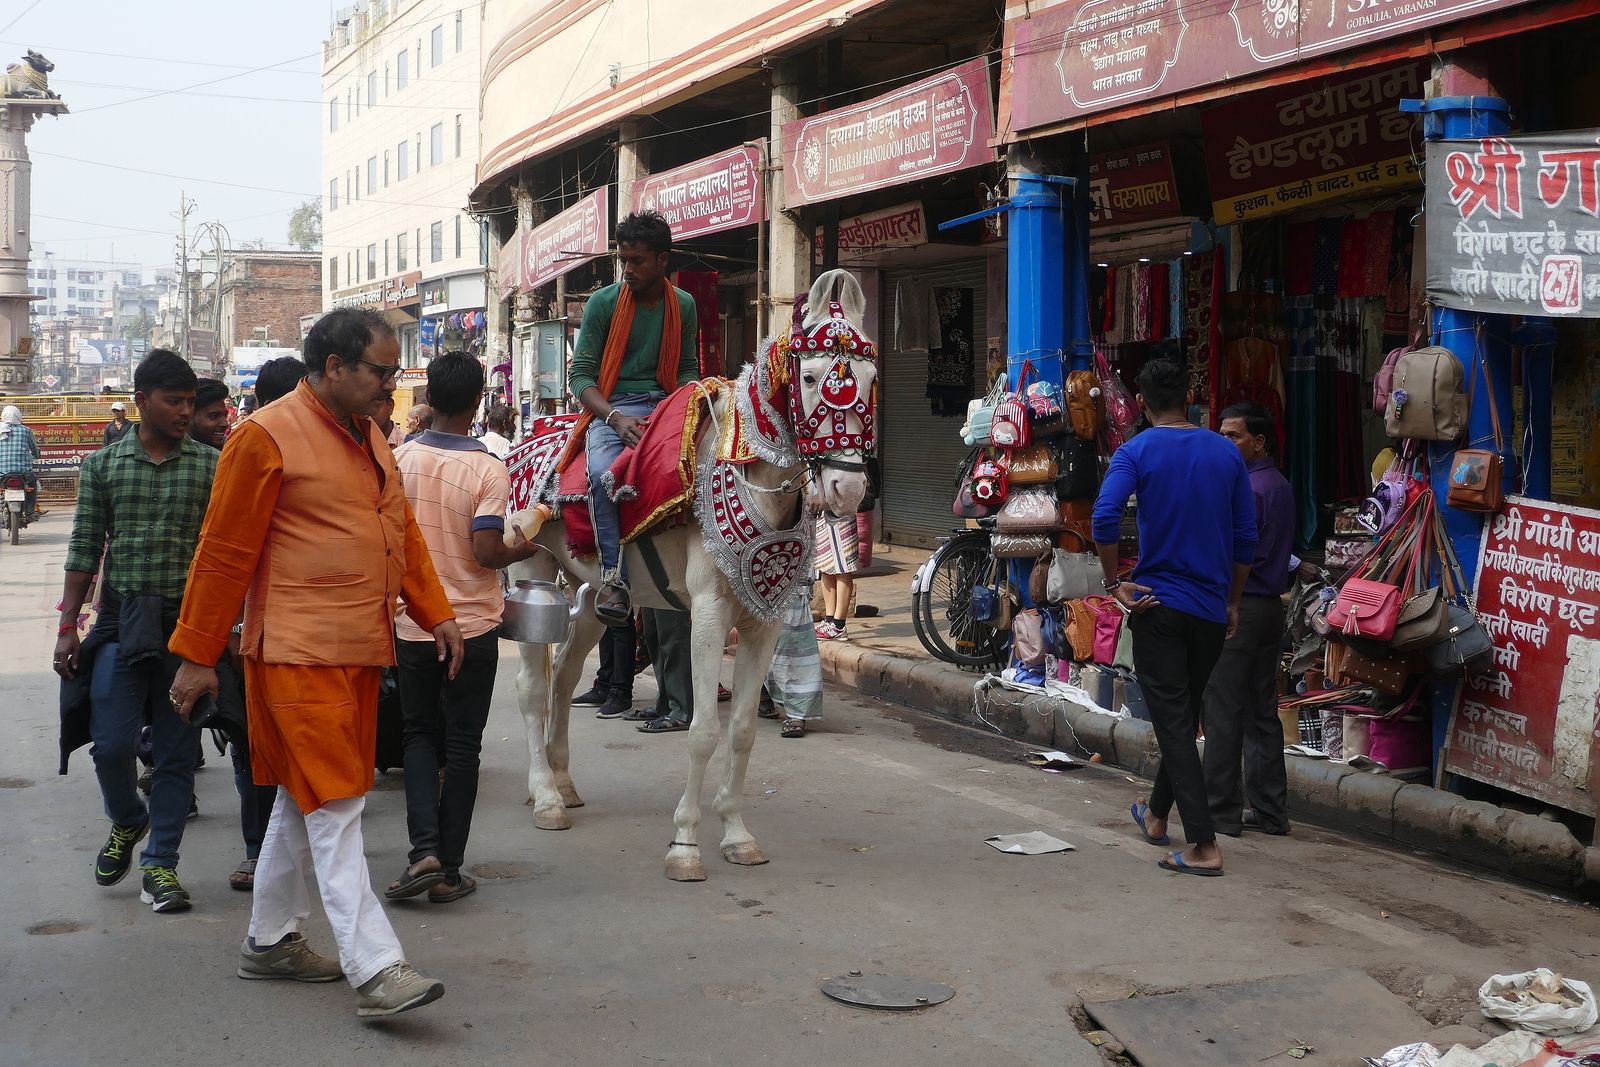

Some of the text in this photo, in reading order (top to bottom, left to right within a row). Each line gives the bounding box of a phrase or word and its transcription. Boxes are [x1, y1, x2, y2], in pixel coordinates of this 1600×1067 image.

[1120, 23, 1135, 44] एवं
[1346, 10, 1392, 30] GODAULIA,
[1393, 0, 1437, 17] VARANASI
[1116, 45, 1147, 64] मंत्रालय
[1092, 68, 1143, 91] भारत सरकार
[1276, 62, 1420, 127] दयाराम
[829, 122, 864, 150] दयाराम
[902, 100, 927, 130] हाउस
[829, 131, 931, 174] DAYARAM HANDLOOM HOUSE
[659, 180, 687, 209] गोपाल
[688, 169, 729, 200] वस्त्रालय
[1446, 137, 1525, 220] श्री
[663, 209, 681, 225] OPAL
[682, 194, 731, 220] VASTRALAYA
[1453, 220, 1508, 261] विशेष
[1547, 220, 1566, 253] के
[1493, 507, 1523, 542] श्री
[1525, 514, 1575, 551] गांधी
[1499, 576, 1599, 631] विशेष छूट
[1510, 617, 1550, 649] खादी
